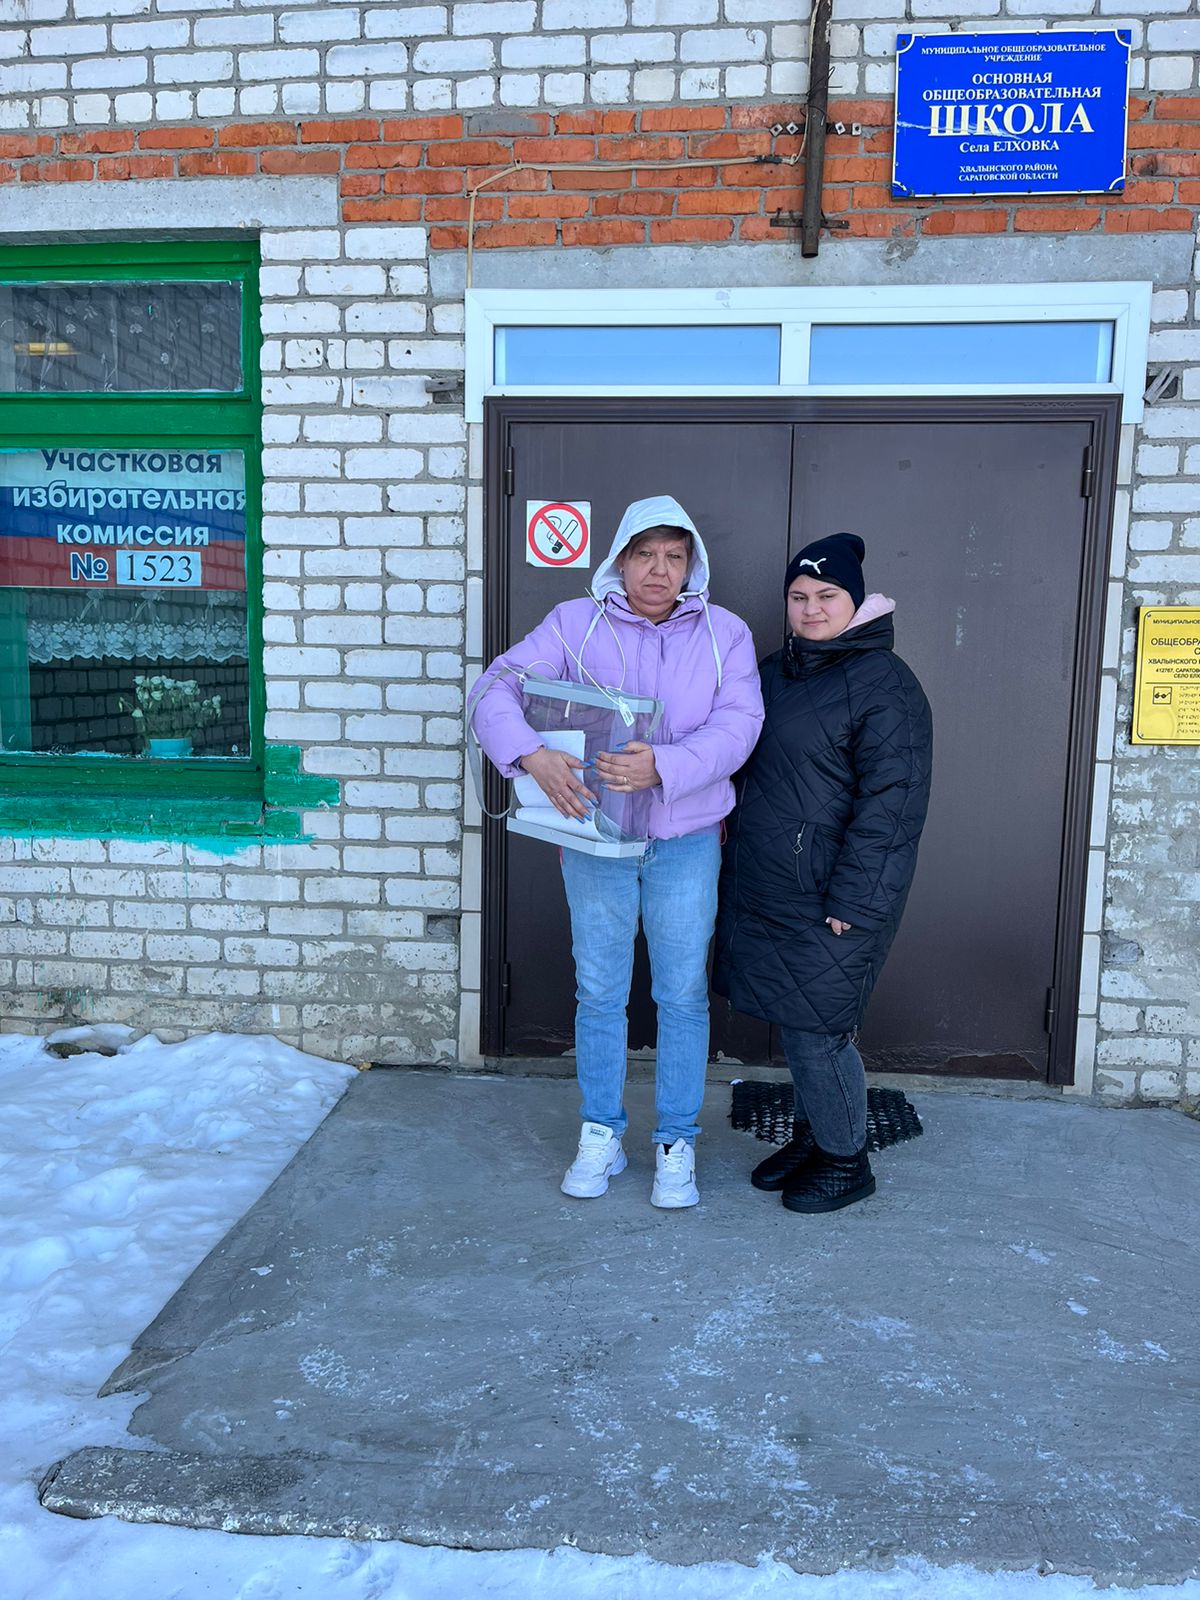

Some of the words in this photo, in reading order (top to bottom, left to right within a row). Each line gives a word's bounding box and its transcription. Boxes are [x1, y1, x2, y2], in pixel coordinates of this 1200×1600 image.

[921, 46, 999, 55] МУНИЦИПАЛЬНОЕ
[1000, 44, 1106, 53] ОБЩЕОБРАЗОВАТЕЛЬНОЕ
[984, 54, 1042, 63] УЧРЕЖДЕНИЕ
[972, 72, 1052, 85] ОСНОВНАЯ
[922, 86, 1101, 102] ОБЩЕОБРАЗОВАТЕЛЬНАЯ
[928, 103, 1094, 136] ШКОЛА
[959, 142, 989, 153] Села
[993, 140, 1059, 152] ЕЛХОВКА
[959, 164, 1023, 173] ХВАЛЫНСКОГО
[1024, 163, 1058, 171] РАЙОНА
[958, 172, 1017, 182] САРАТОВСКОЙ
[1019, 172, 1058, 180] ОБЛАСТИ
[42, 450, 221, 473] Участковая
[13, 480, 246, 515] избирательная
[57, 524, 209, 546] комиссия
[70, 552, 109, 581] №
[126, 554, 193, 583] 1523
